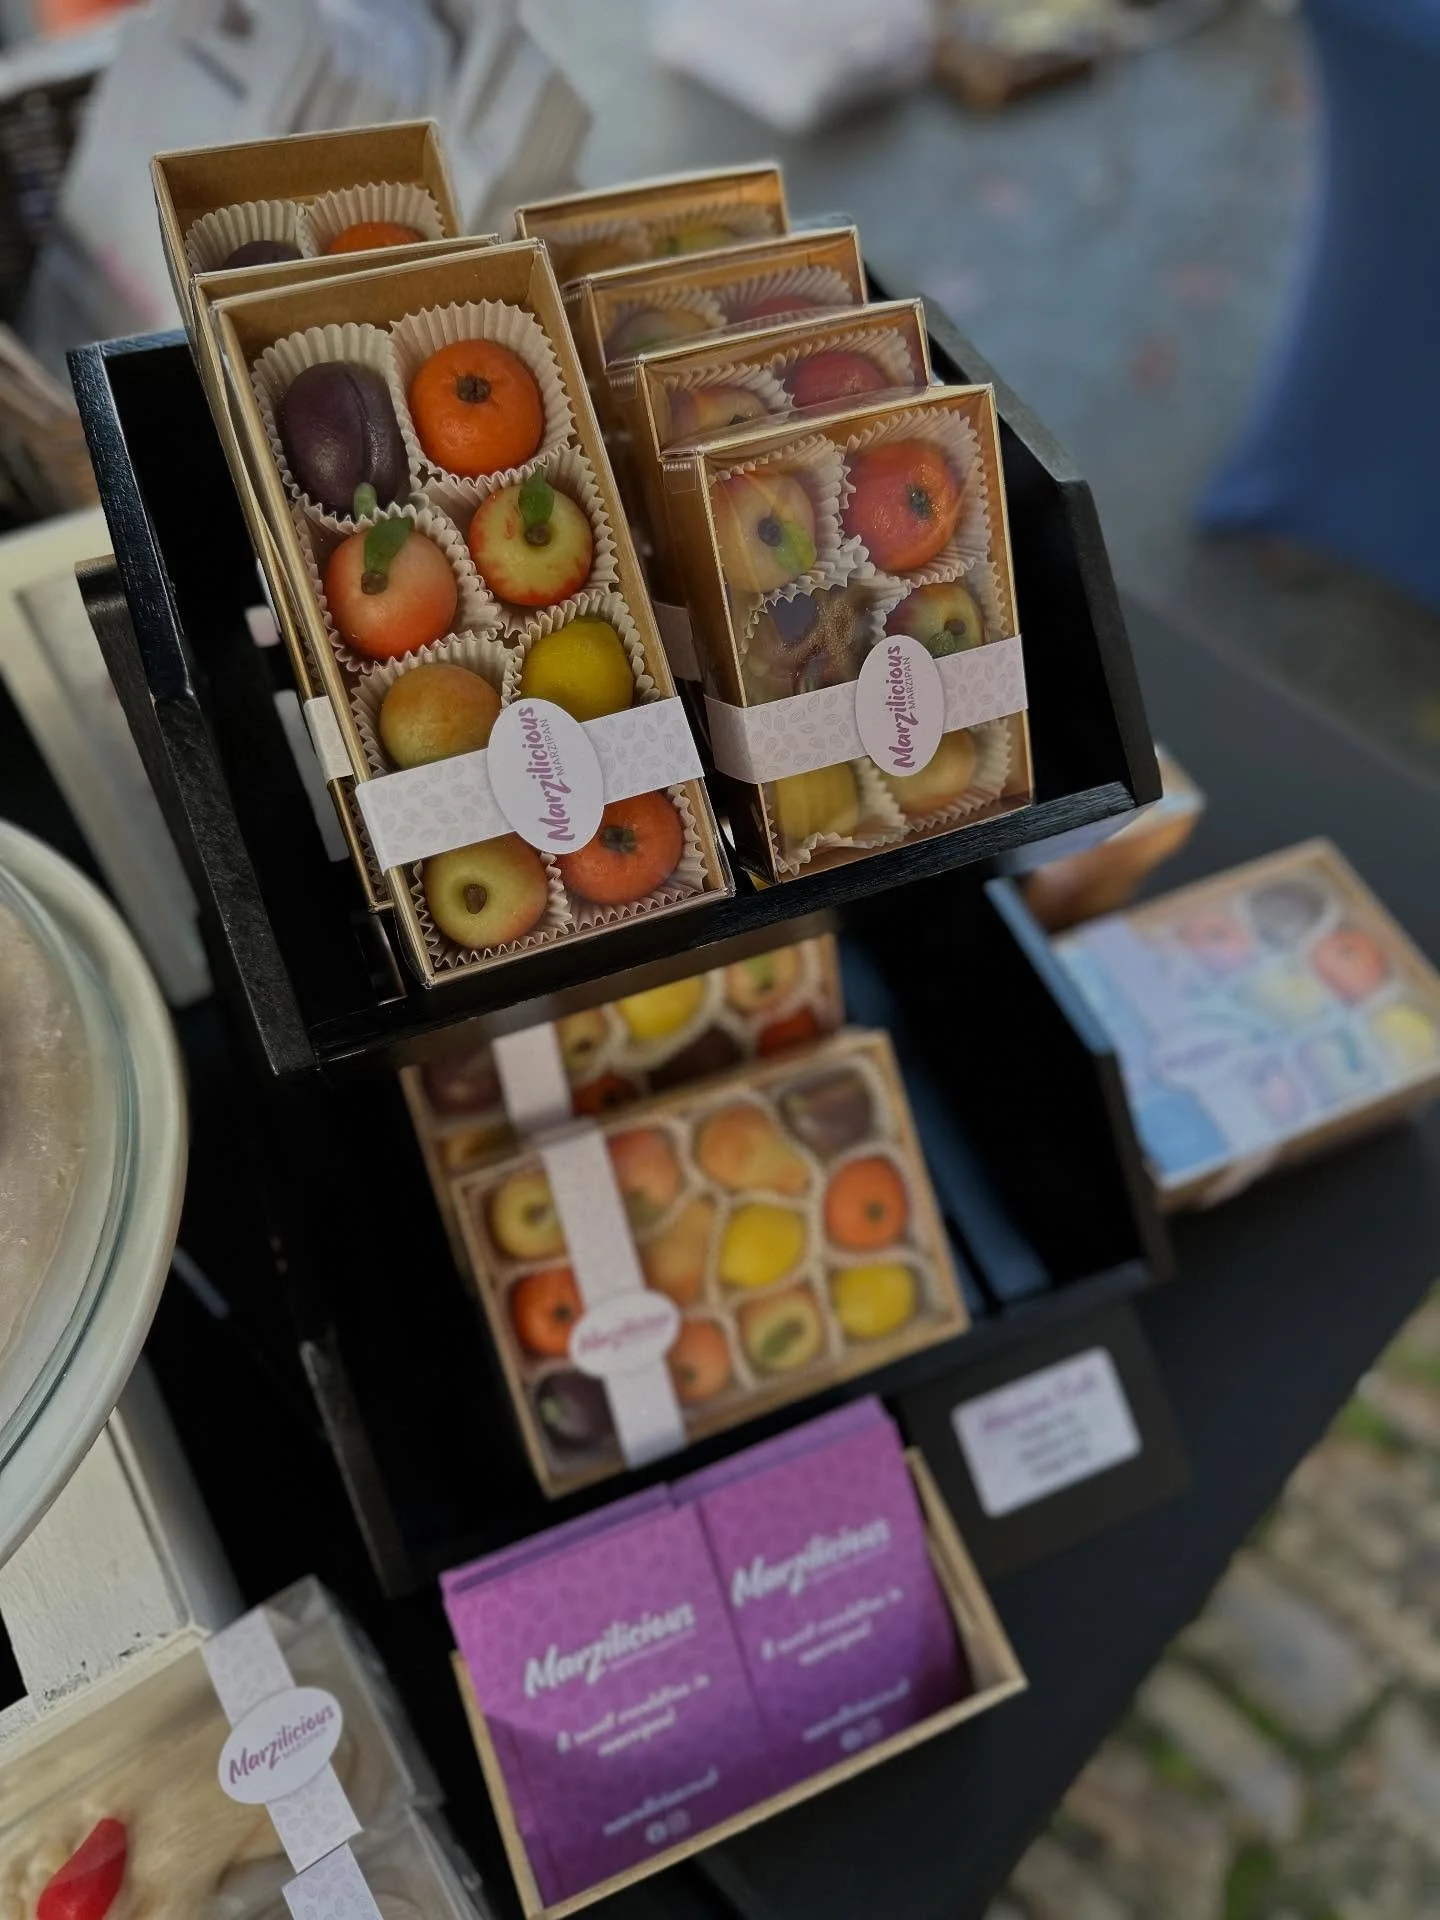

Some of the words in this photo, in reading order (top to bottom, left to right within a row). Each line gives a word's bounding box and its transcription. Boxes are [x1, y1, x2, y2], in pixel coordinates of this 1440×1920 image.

[885, 645, 919, 768] Marzilicious
[902, 657, 916, 709] MARZIPAN
[518, 706, 576, 842] Marzilicious
[540, 719, 567, 777] MARZIPAN
[524, 1602, 696, 1699] Marzilicious
[228, 1704, 335, 1785] Marzilicious
